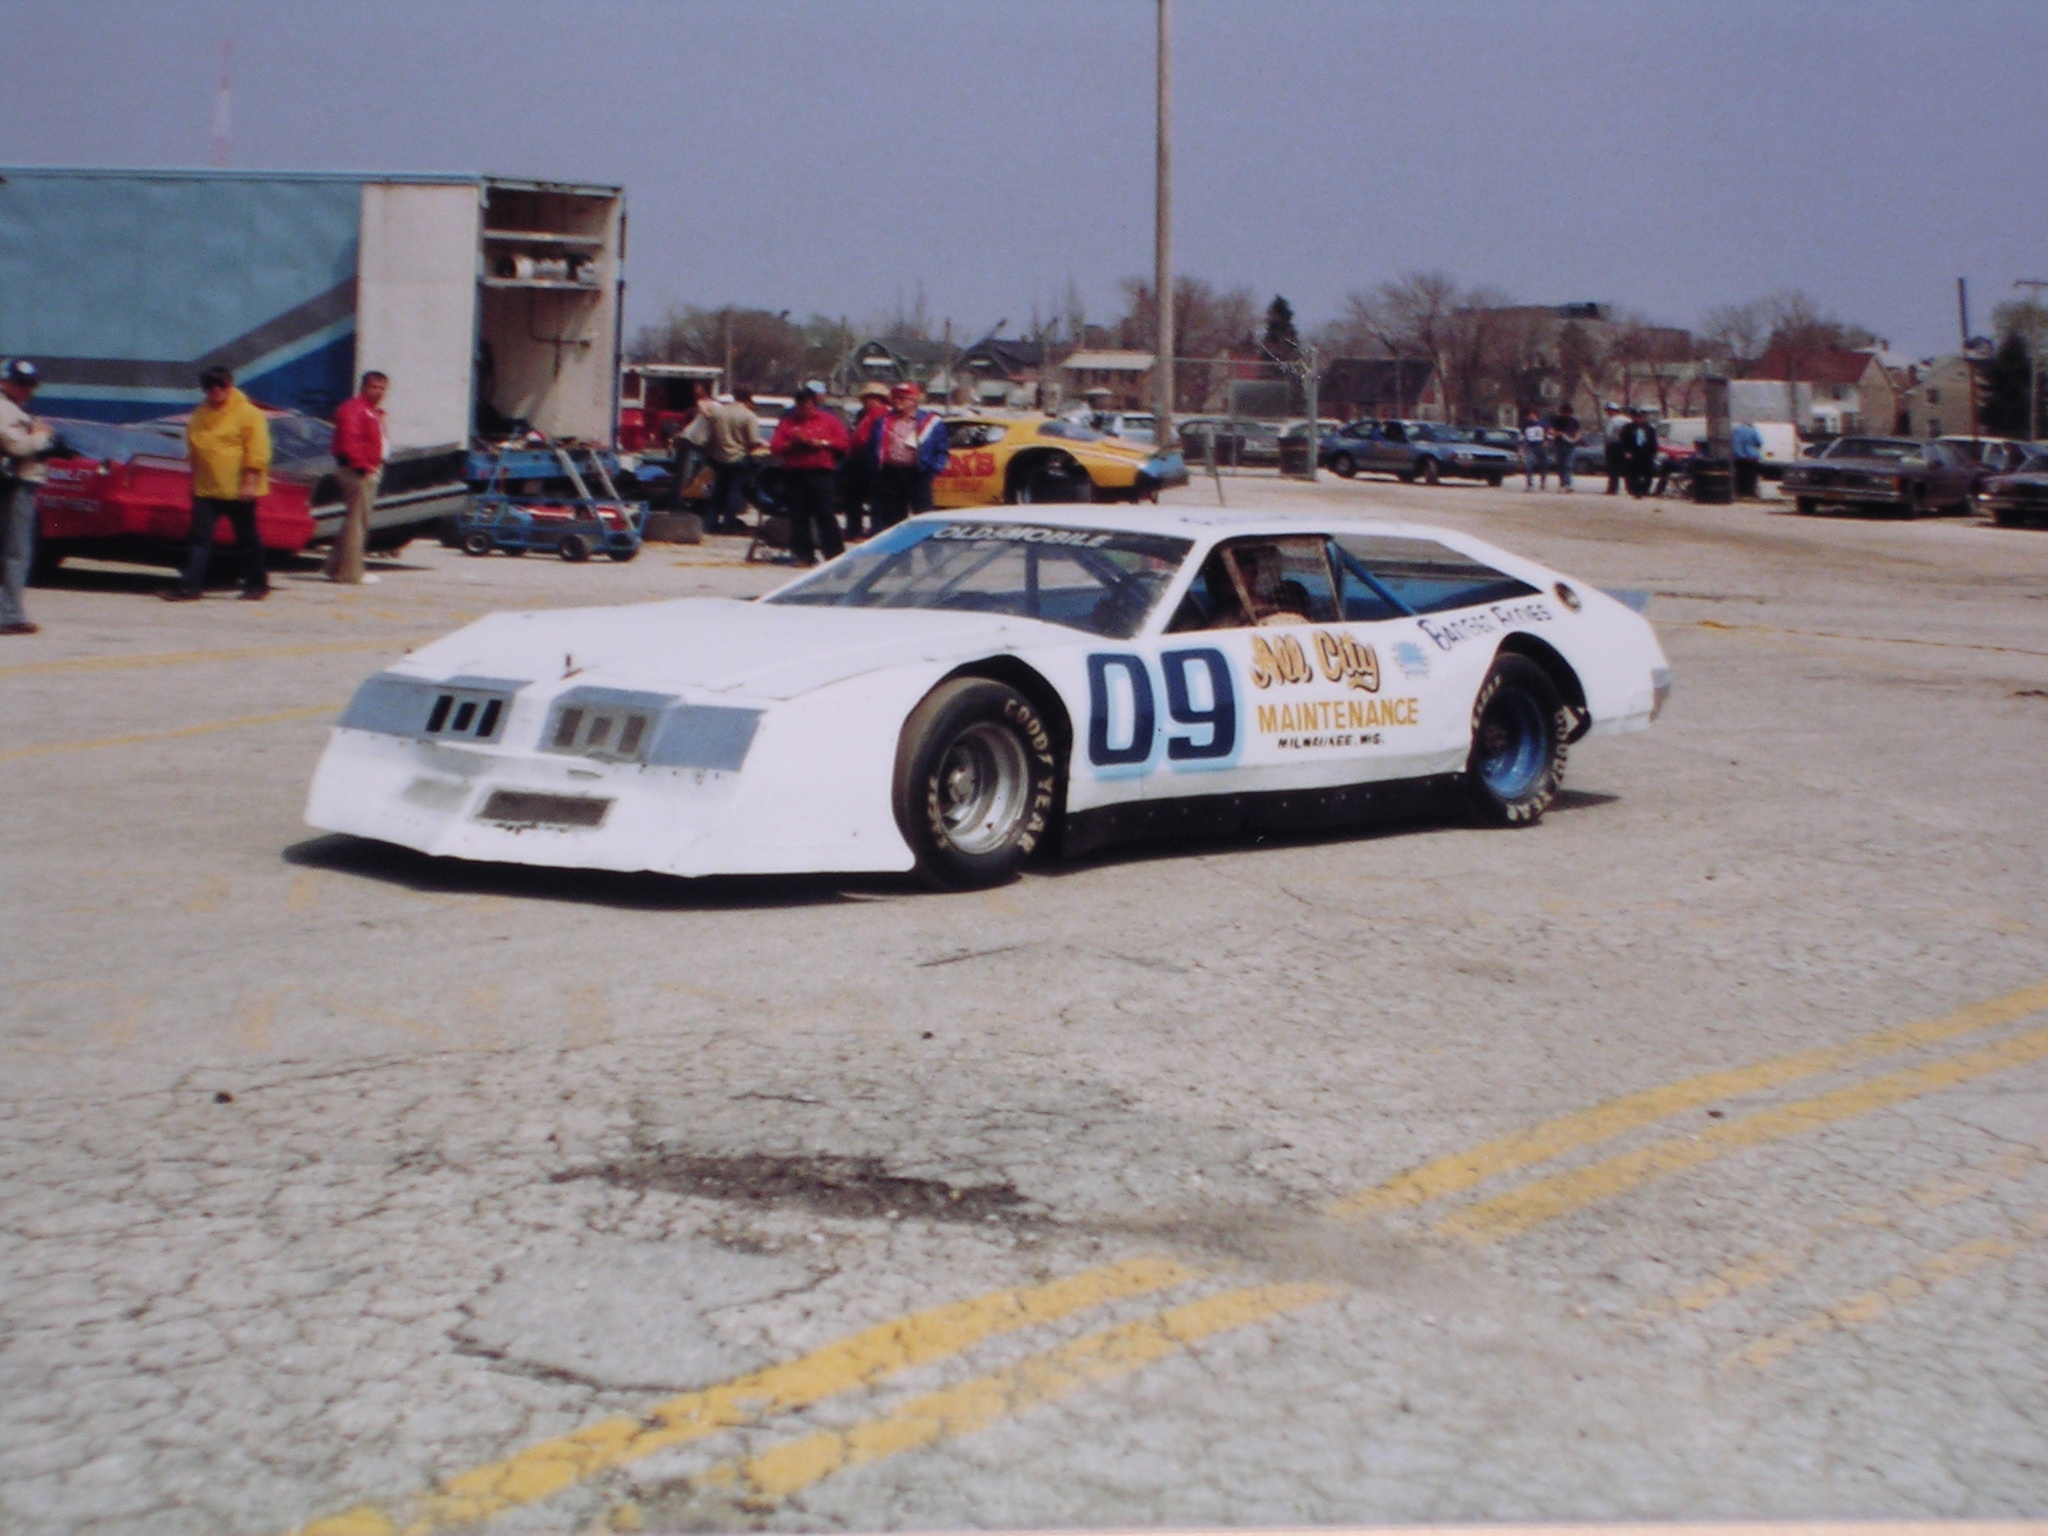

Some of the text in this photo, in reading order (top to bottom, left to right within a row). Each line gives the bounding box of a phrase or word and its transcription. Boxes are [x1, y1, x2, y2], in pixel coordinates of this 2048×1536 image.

[933, 525, 1113, 547] OLDSMOBILE
[1251, 630, 1380, 693] All City
[1257, 697, 1419, 733] MAINTENANCE
